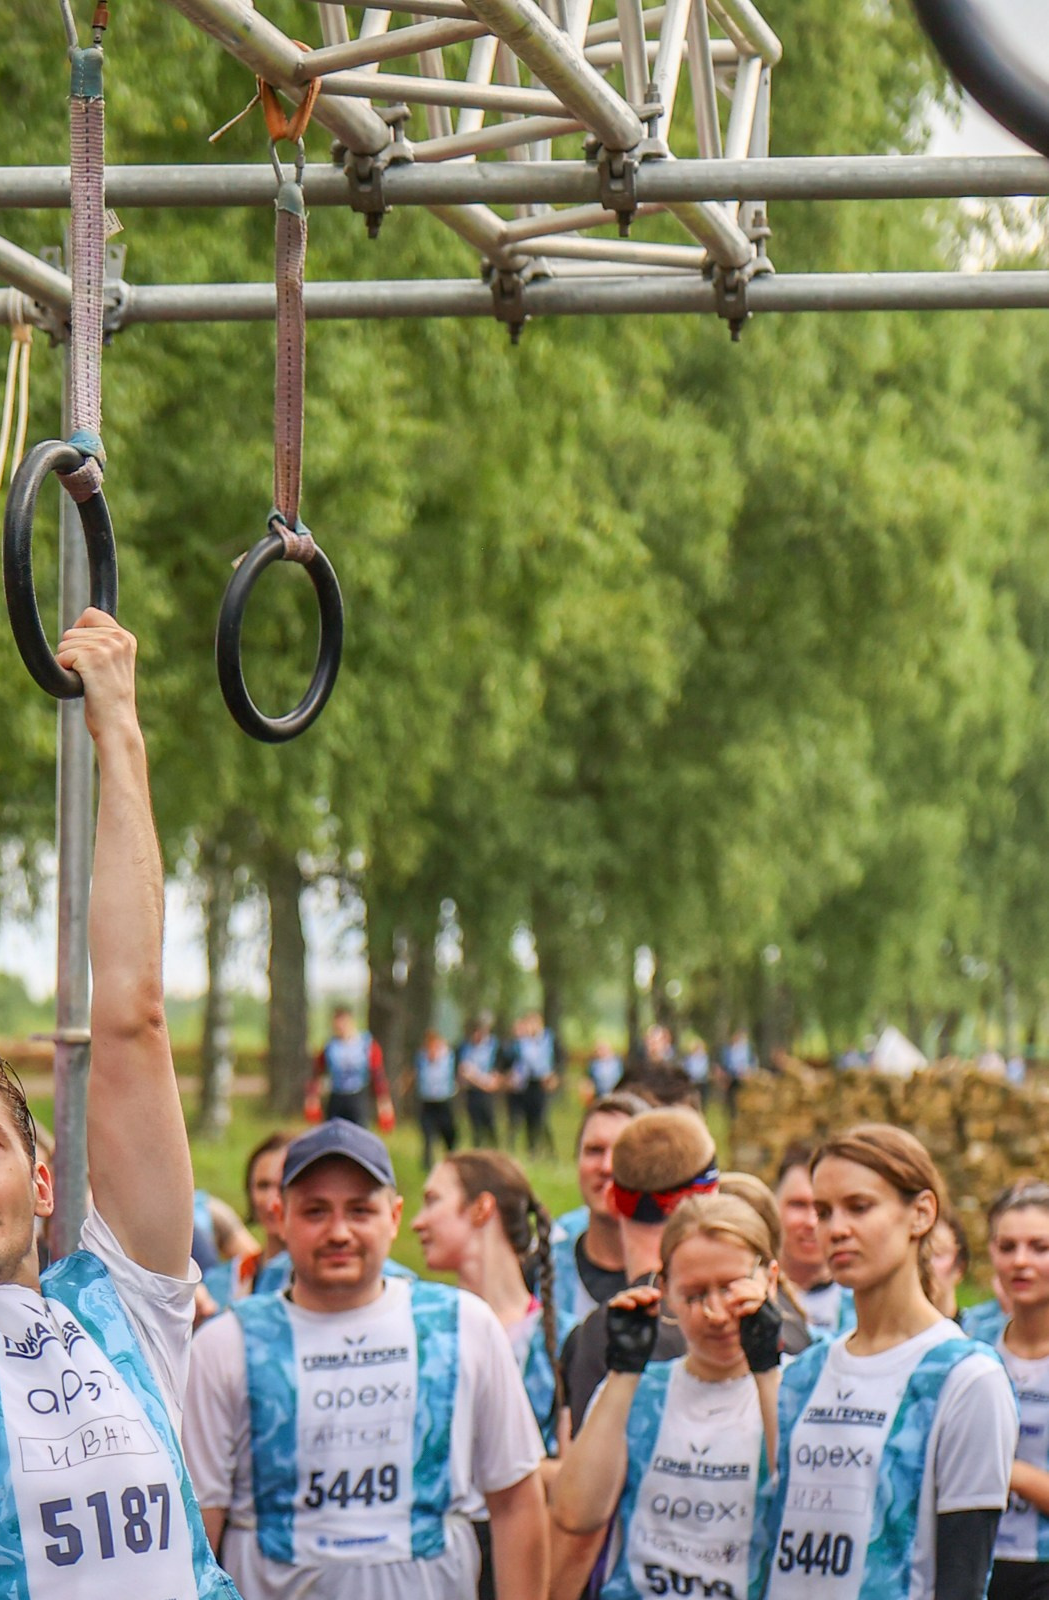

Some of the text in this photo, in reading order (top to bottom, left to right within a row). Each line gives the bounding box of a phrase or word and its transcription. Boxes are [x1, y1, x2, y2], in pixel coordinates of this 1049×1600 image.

[304, 1464, 398, 1509] 5449
[39, 1483, 170, 1567] 5187
[778, 1531, 854, 1576] 5440
